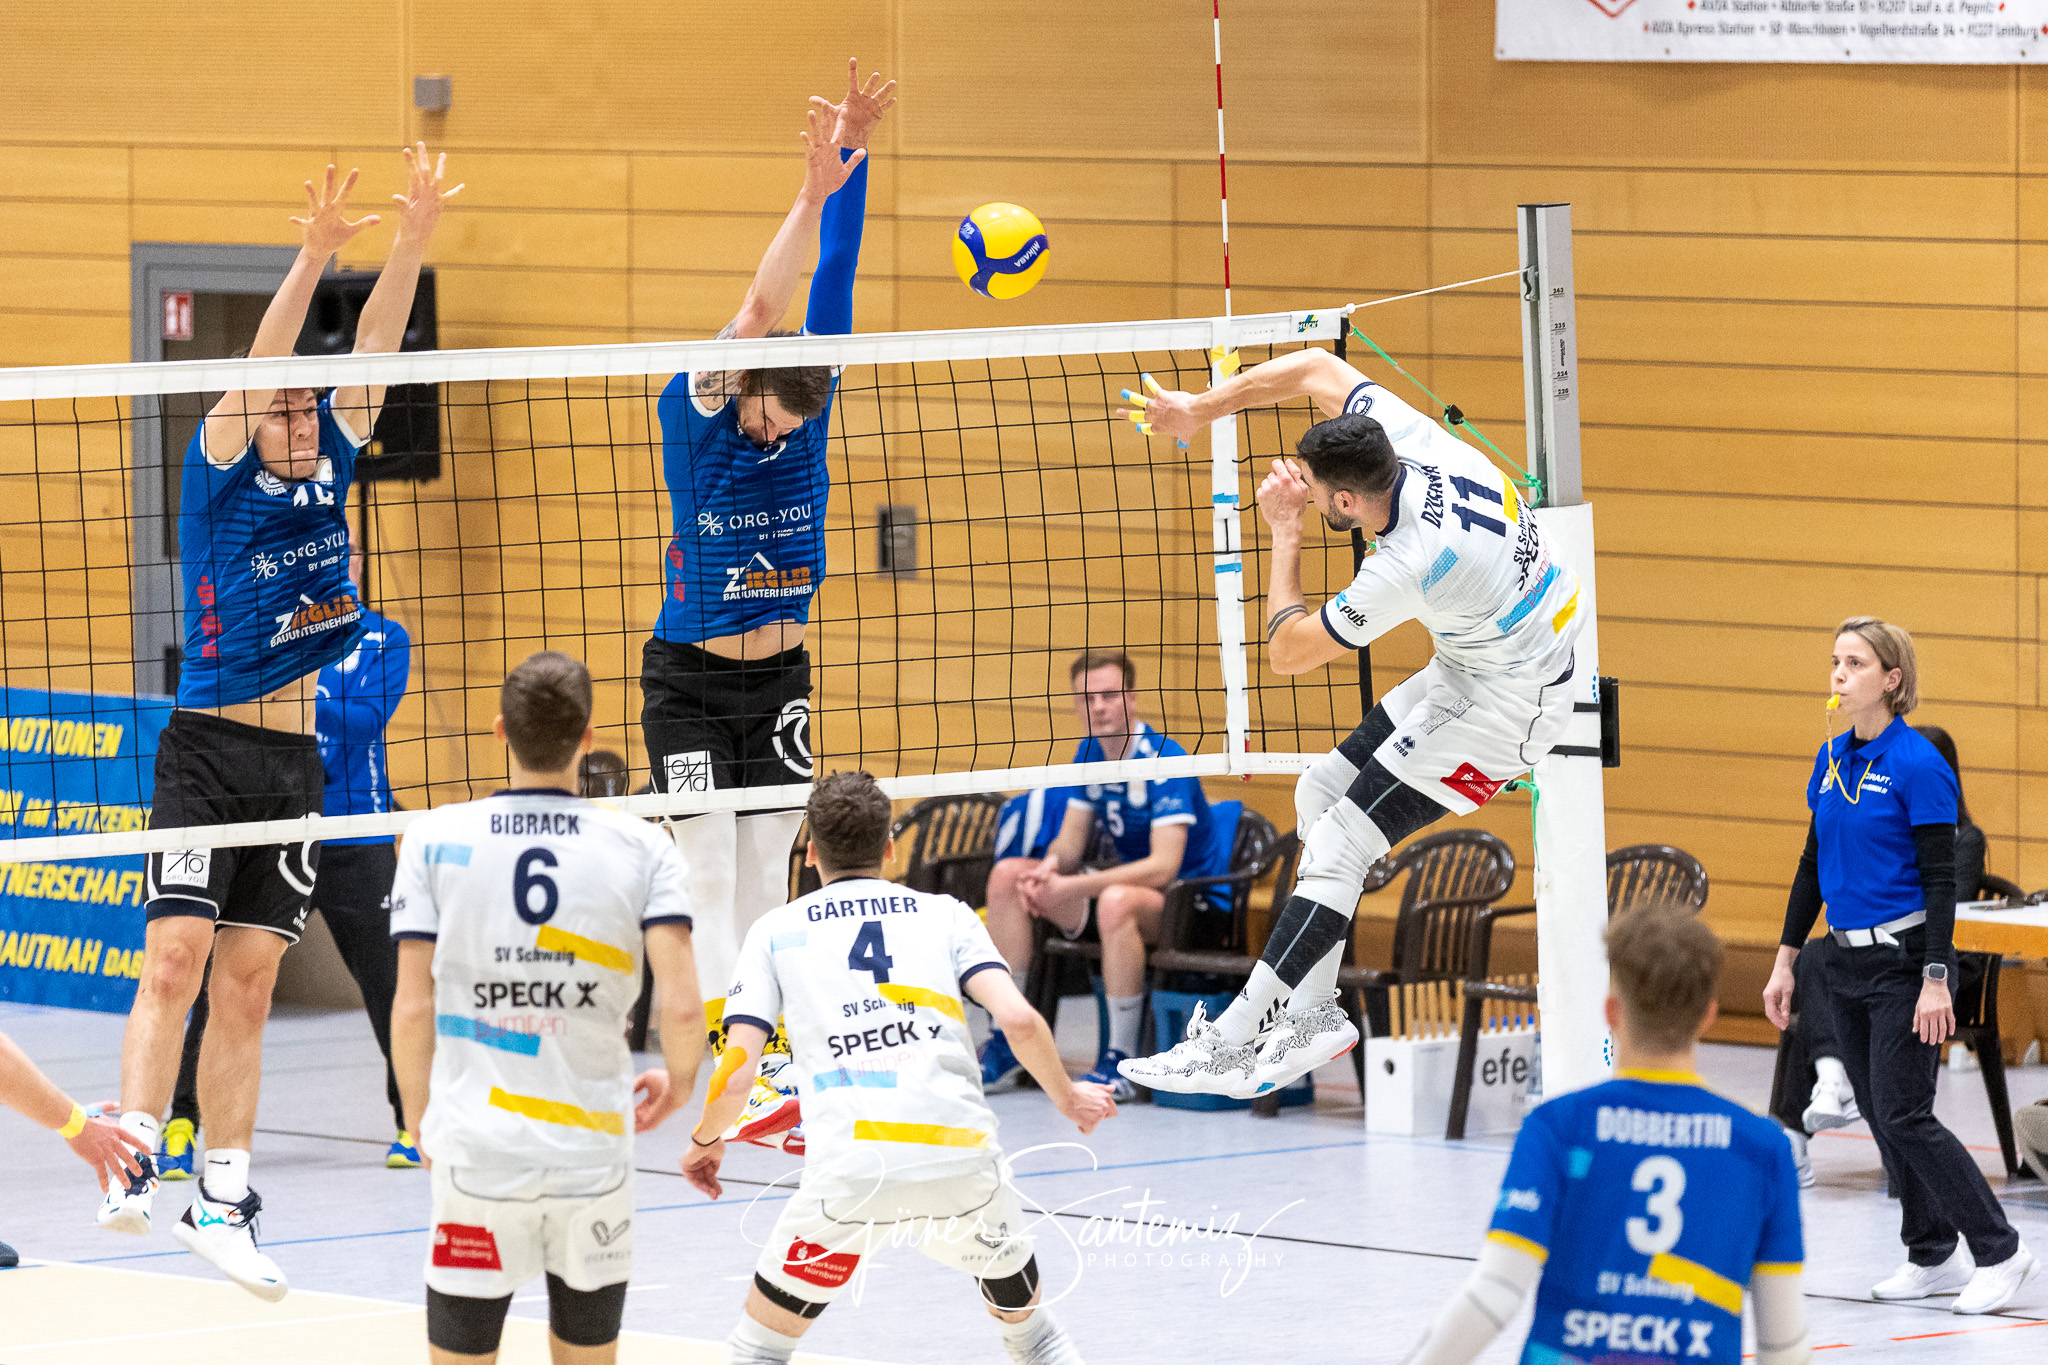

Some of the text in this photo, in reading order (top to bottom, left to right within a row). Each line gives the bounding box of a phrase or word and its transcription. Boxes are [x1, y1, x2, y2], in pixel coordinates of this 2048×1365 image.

[729, 504, 812, 530] ORG-YOU
[1448, 474, 1506, 538] 11
[722, 583, 813, 602] BAUUNTERNEHMEN
[269, 609, 361, 649] BAUUNTERNEHMEN
[1339, 604, 1369, 628] puls
[490, 812, 580, 836] BIBRACK
[512, 847, 560, 926] 6
[807, 896, 918, 923] GÄRTNER
[495, 946, 511, 962] SV
[847, 920, 895, 985] 4
[474, 982, 565, 1009] SPECK
[843, 998, 916, 1018] SV Schaig
[827, 1020, 921, 1060] SPECK
[1625, 1155, 1688, 1258] 3
[1562, 1309, 1682, 1354] SPECK
